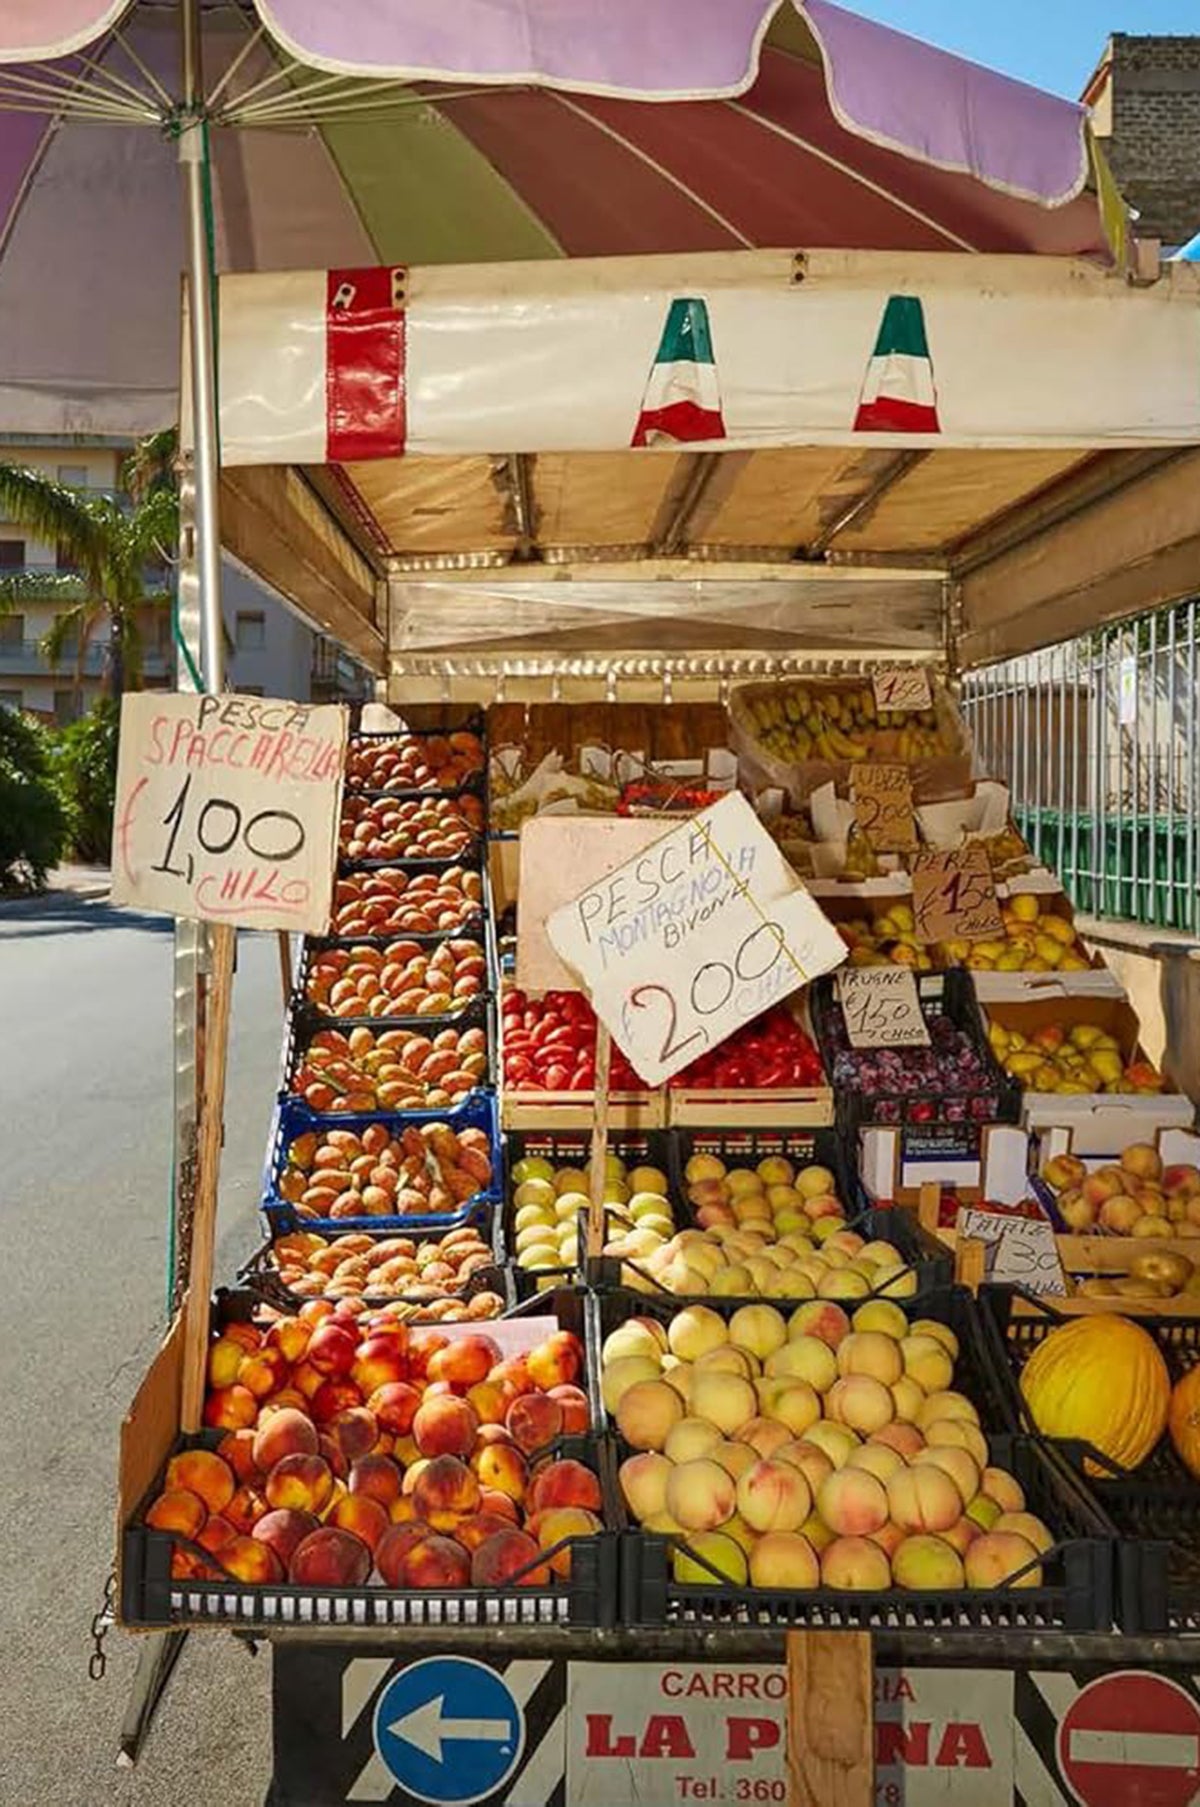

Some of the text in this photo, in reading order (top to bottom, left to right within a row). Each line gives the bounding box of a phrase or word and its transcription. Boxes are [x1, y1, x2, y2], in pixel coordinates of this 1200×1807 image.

[198, 696, 309, 731] PESCA
[579, 820, 712, 943] PESCA
[914, 852, 976, 873] PERE
[195, 870, 310, 912] CHILO
[586, 1714, 992, 1768] LA PNA
[675, 1777, 726, 1799] Tel.
